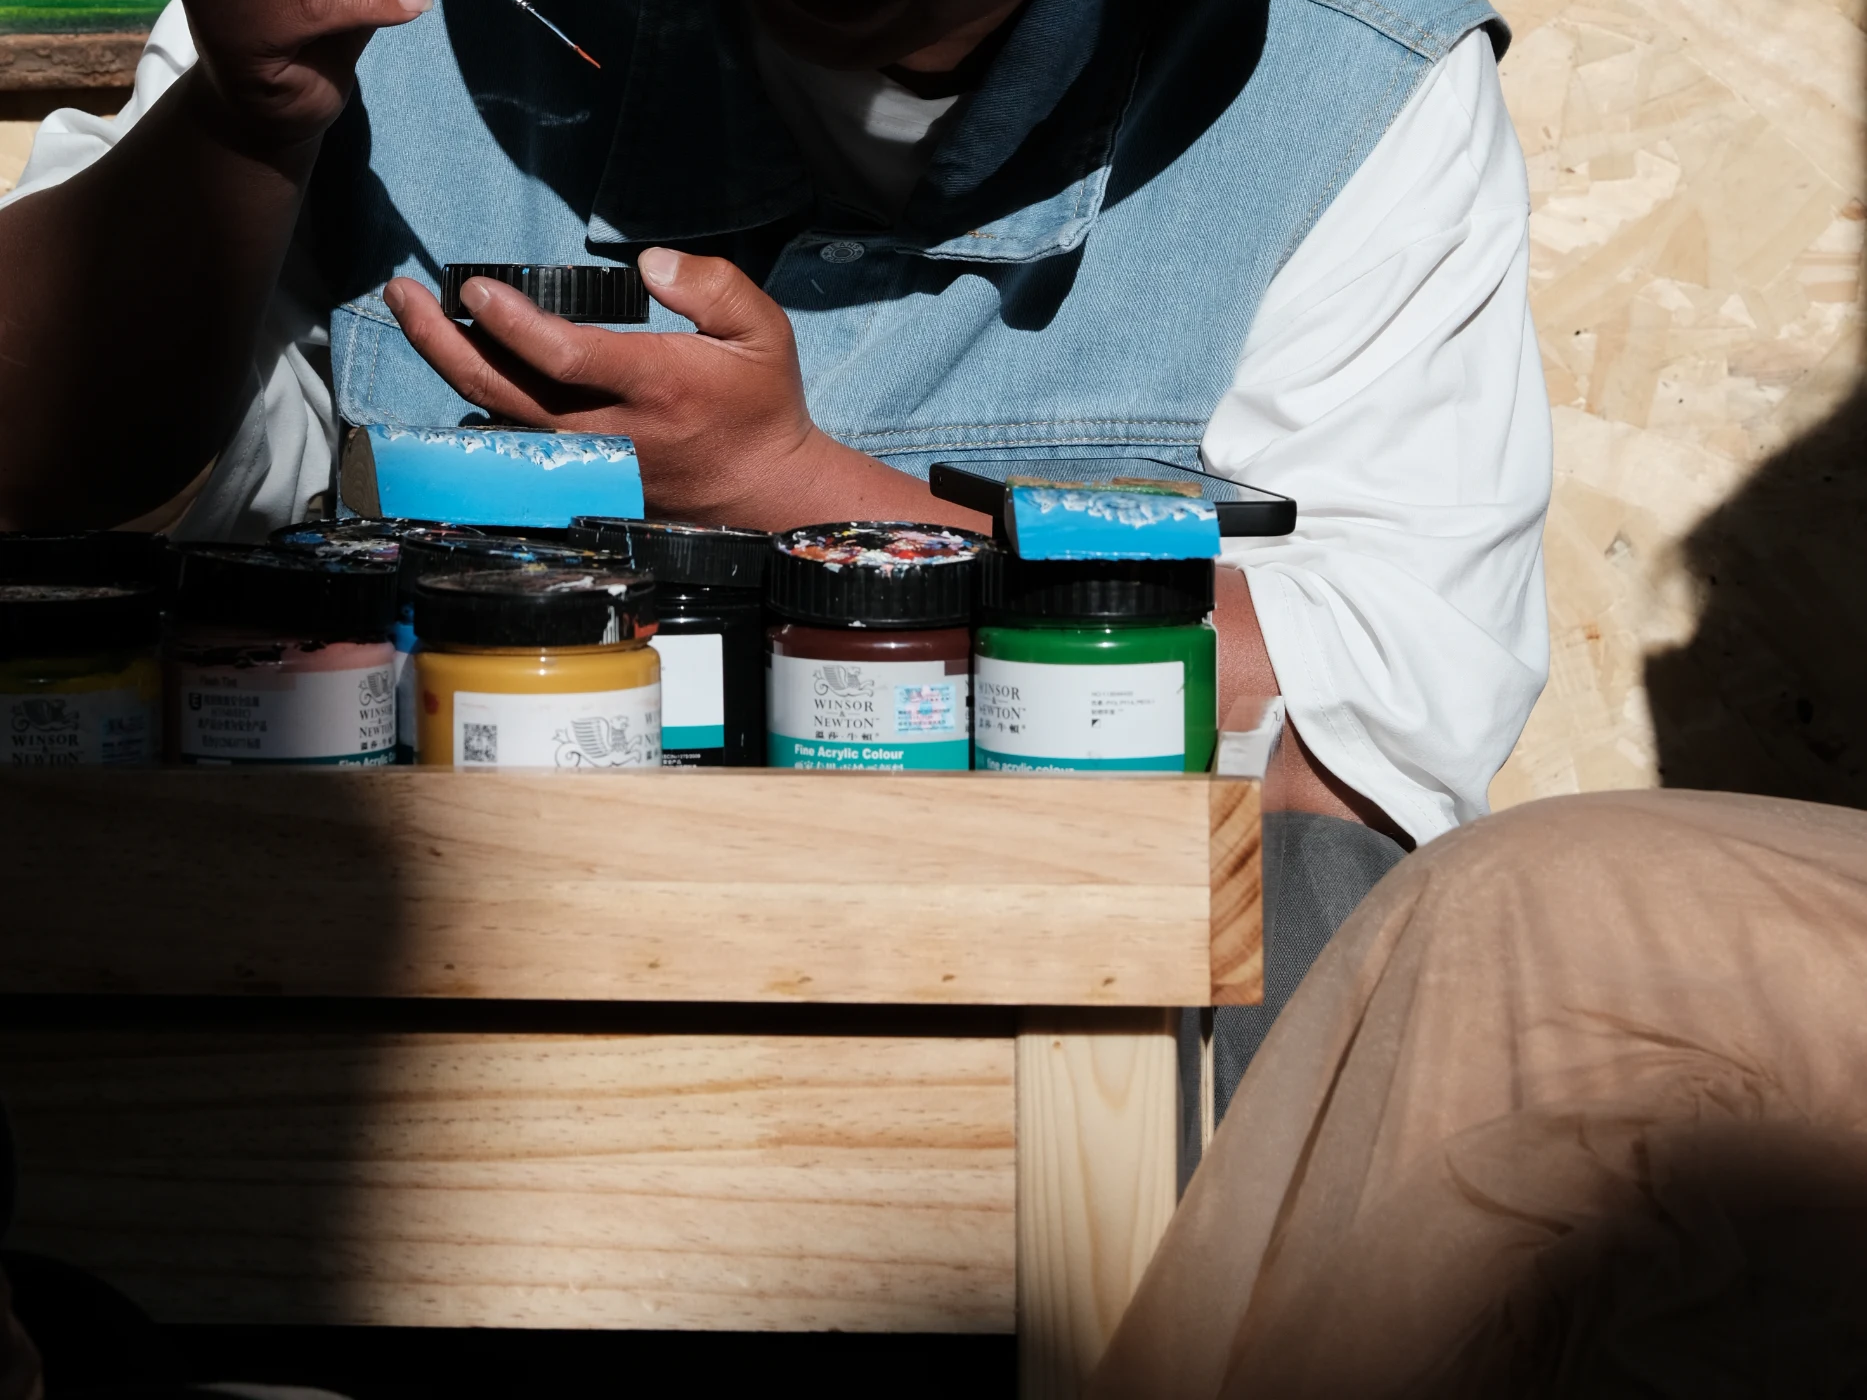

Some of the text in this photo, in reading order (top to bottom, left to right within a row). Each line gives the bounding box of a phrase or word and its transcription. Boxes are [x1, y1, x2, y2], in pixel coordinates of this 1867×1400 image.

[814, 699, 874, 712] WINSOR
[814, 716, 874, 729] NEWTON
[11, 734, 79, 747] WINSOR
[12, 752, 79, 766] NEWTON
[794, 744, 904, 761] Fine Acrylic Colour
